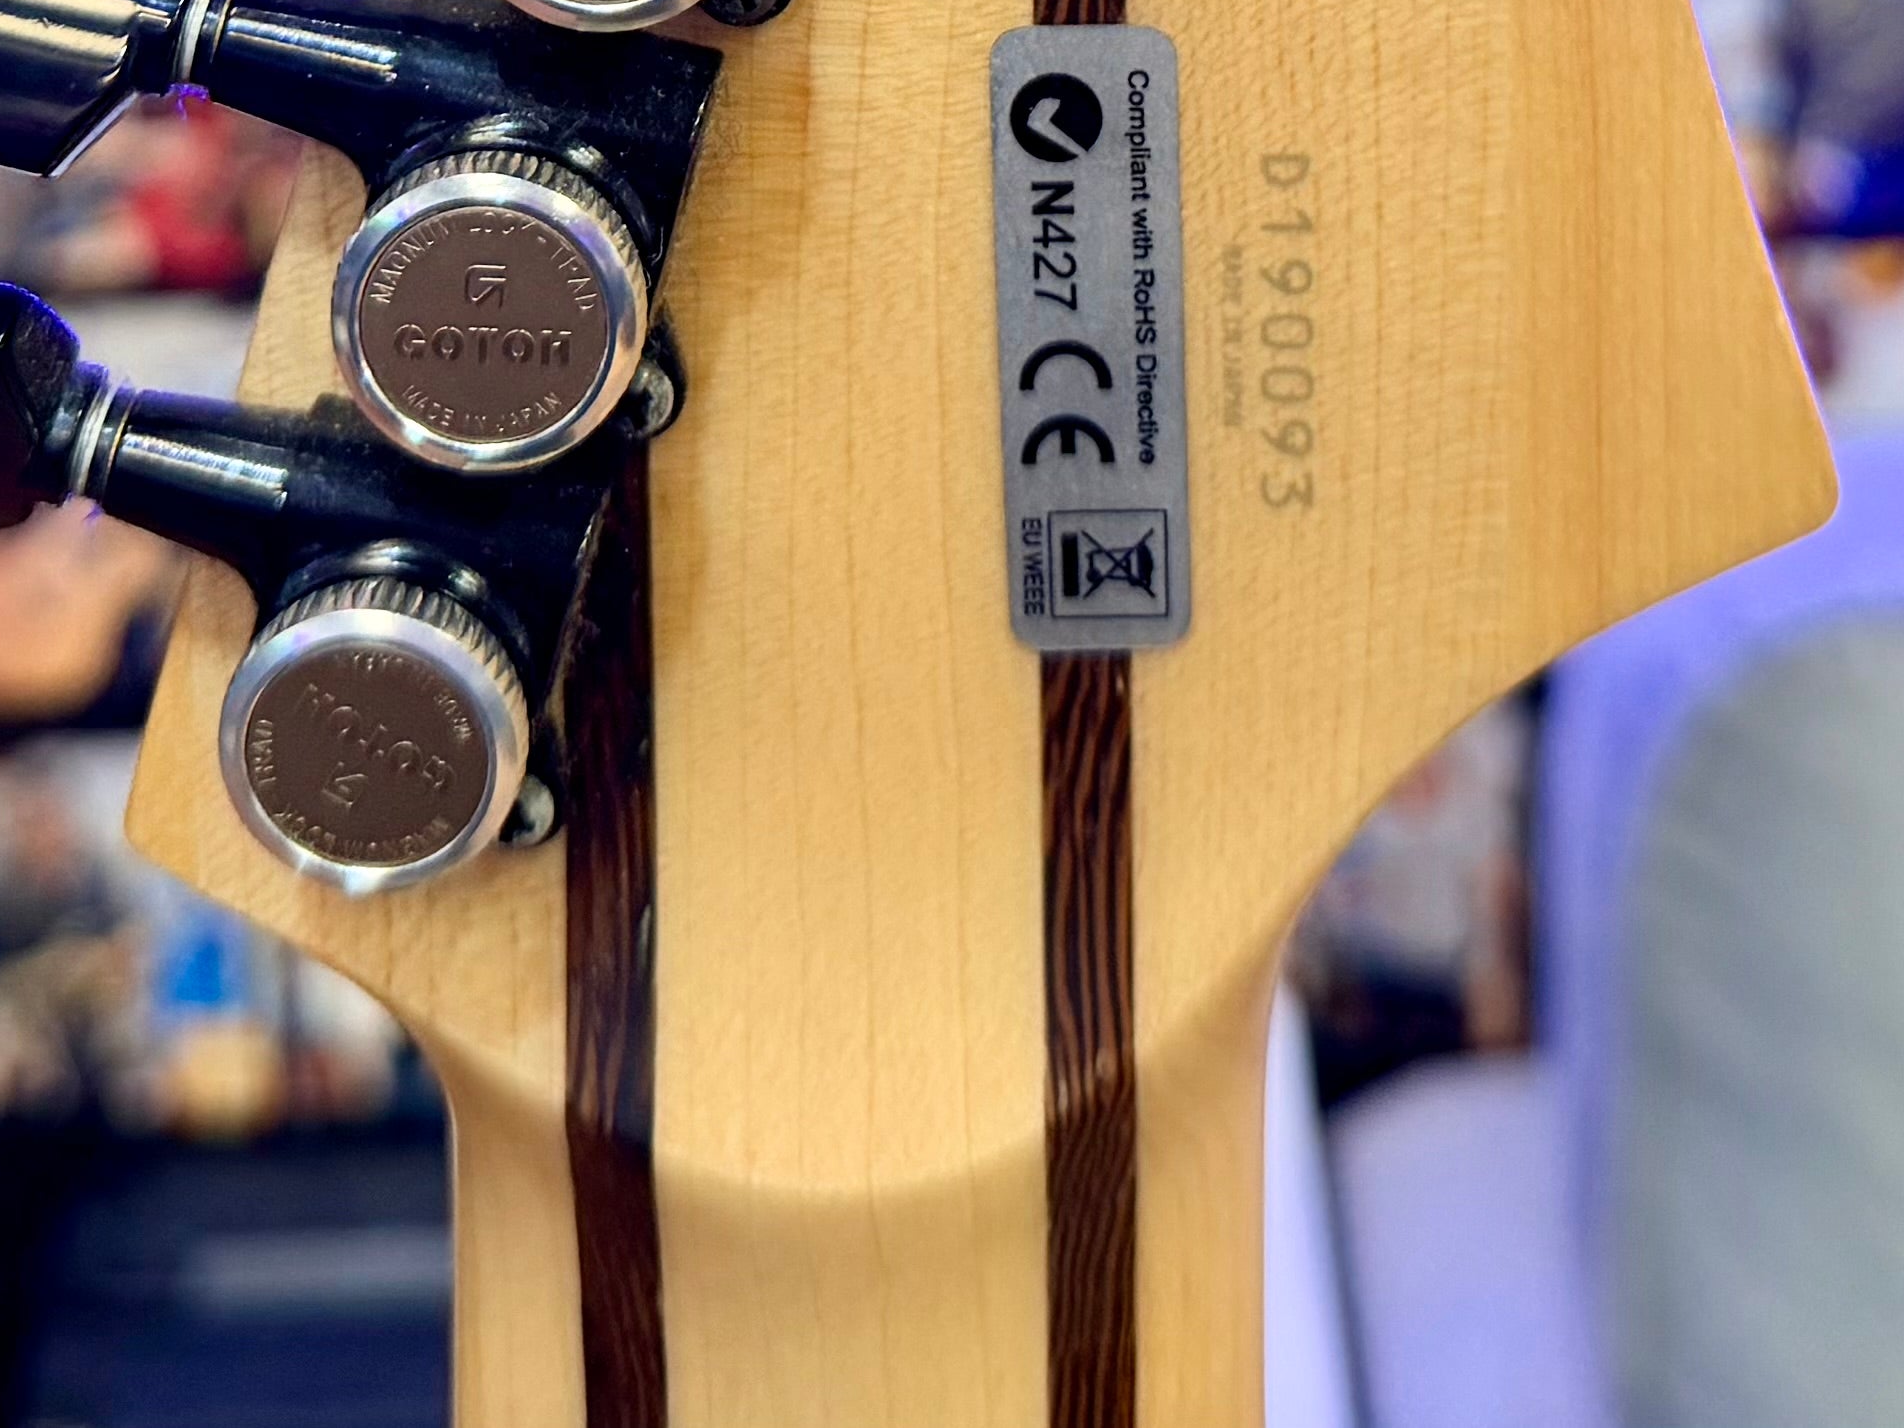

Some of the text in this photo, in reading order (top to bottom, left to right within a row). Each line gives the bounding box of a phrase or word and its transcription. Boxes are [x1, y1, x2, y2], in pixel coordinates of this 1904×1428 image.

[394, 324, 573, 366] GOTOH
[1019, 180, 1115, 468] N427 CE
[1124, 70, 1160, 468] Compliant with RoHS Directive
[1259, 153, 1315, 510] D190093
[1021, 517, 1045, 616] EU WEEE
